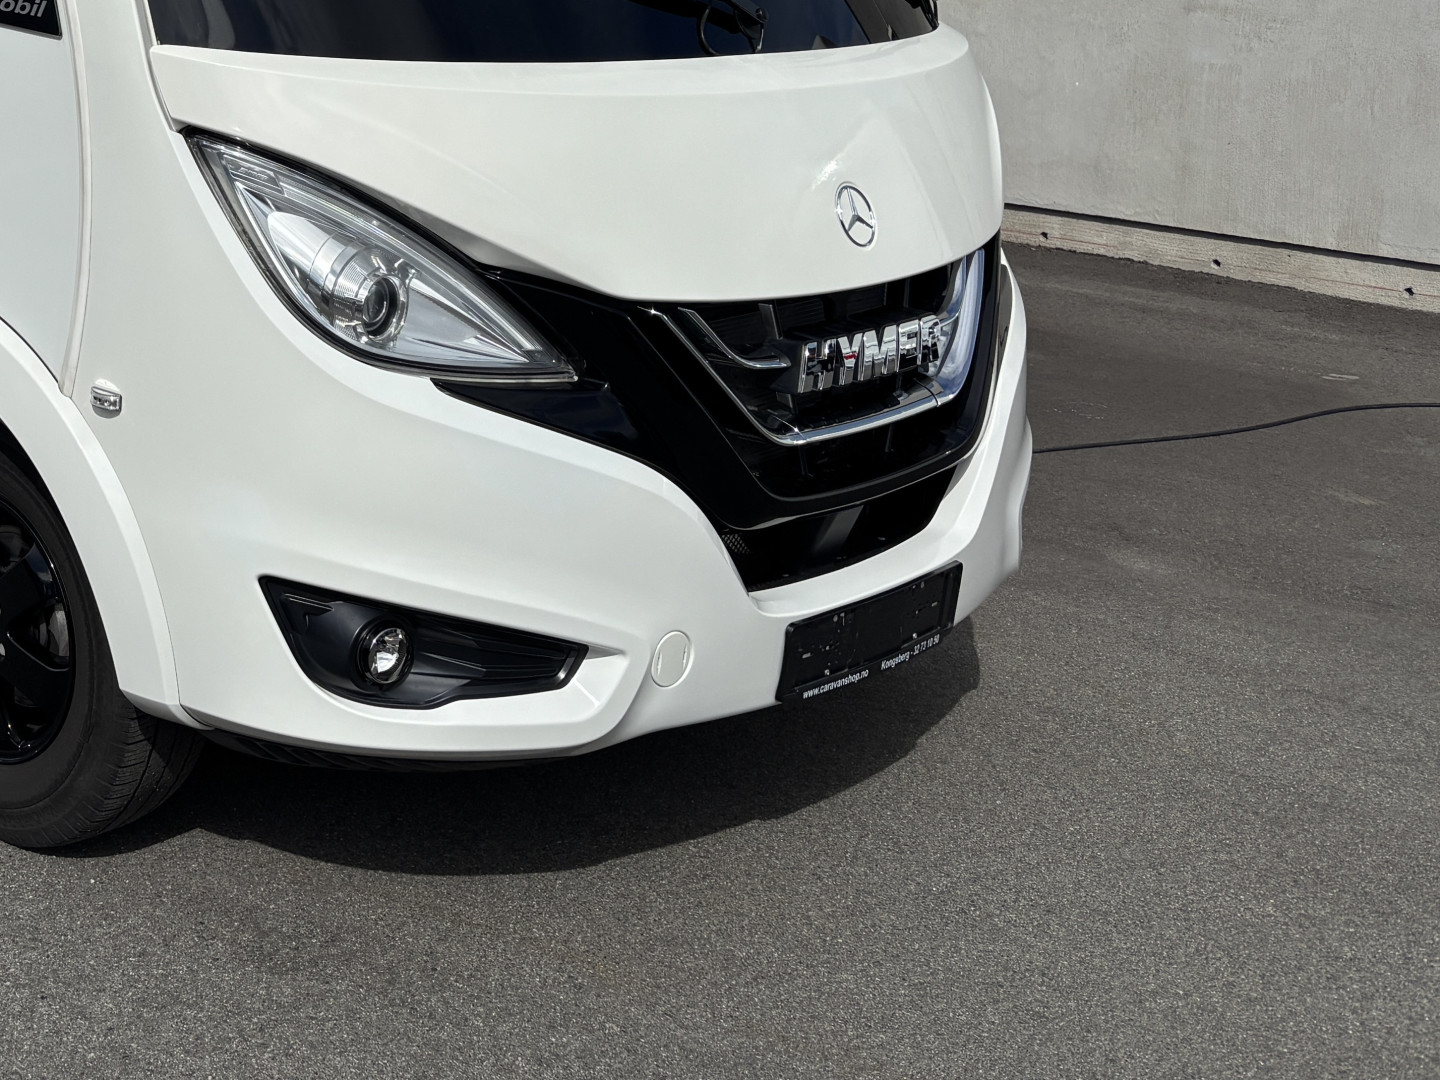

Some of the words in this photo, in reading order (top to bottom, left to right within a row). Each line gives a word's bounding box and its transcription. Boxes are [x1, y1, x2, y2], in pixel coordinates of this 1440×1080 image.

[798, 314, 941, 393] HYMER
[802, 669, 869, 699] www.caravanshop.no
[880, 651, 910, 670] Kongsberg
